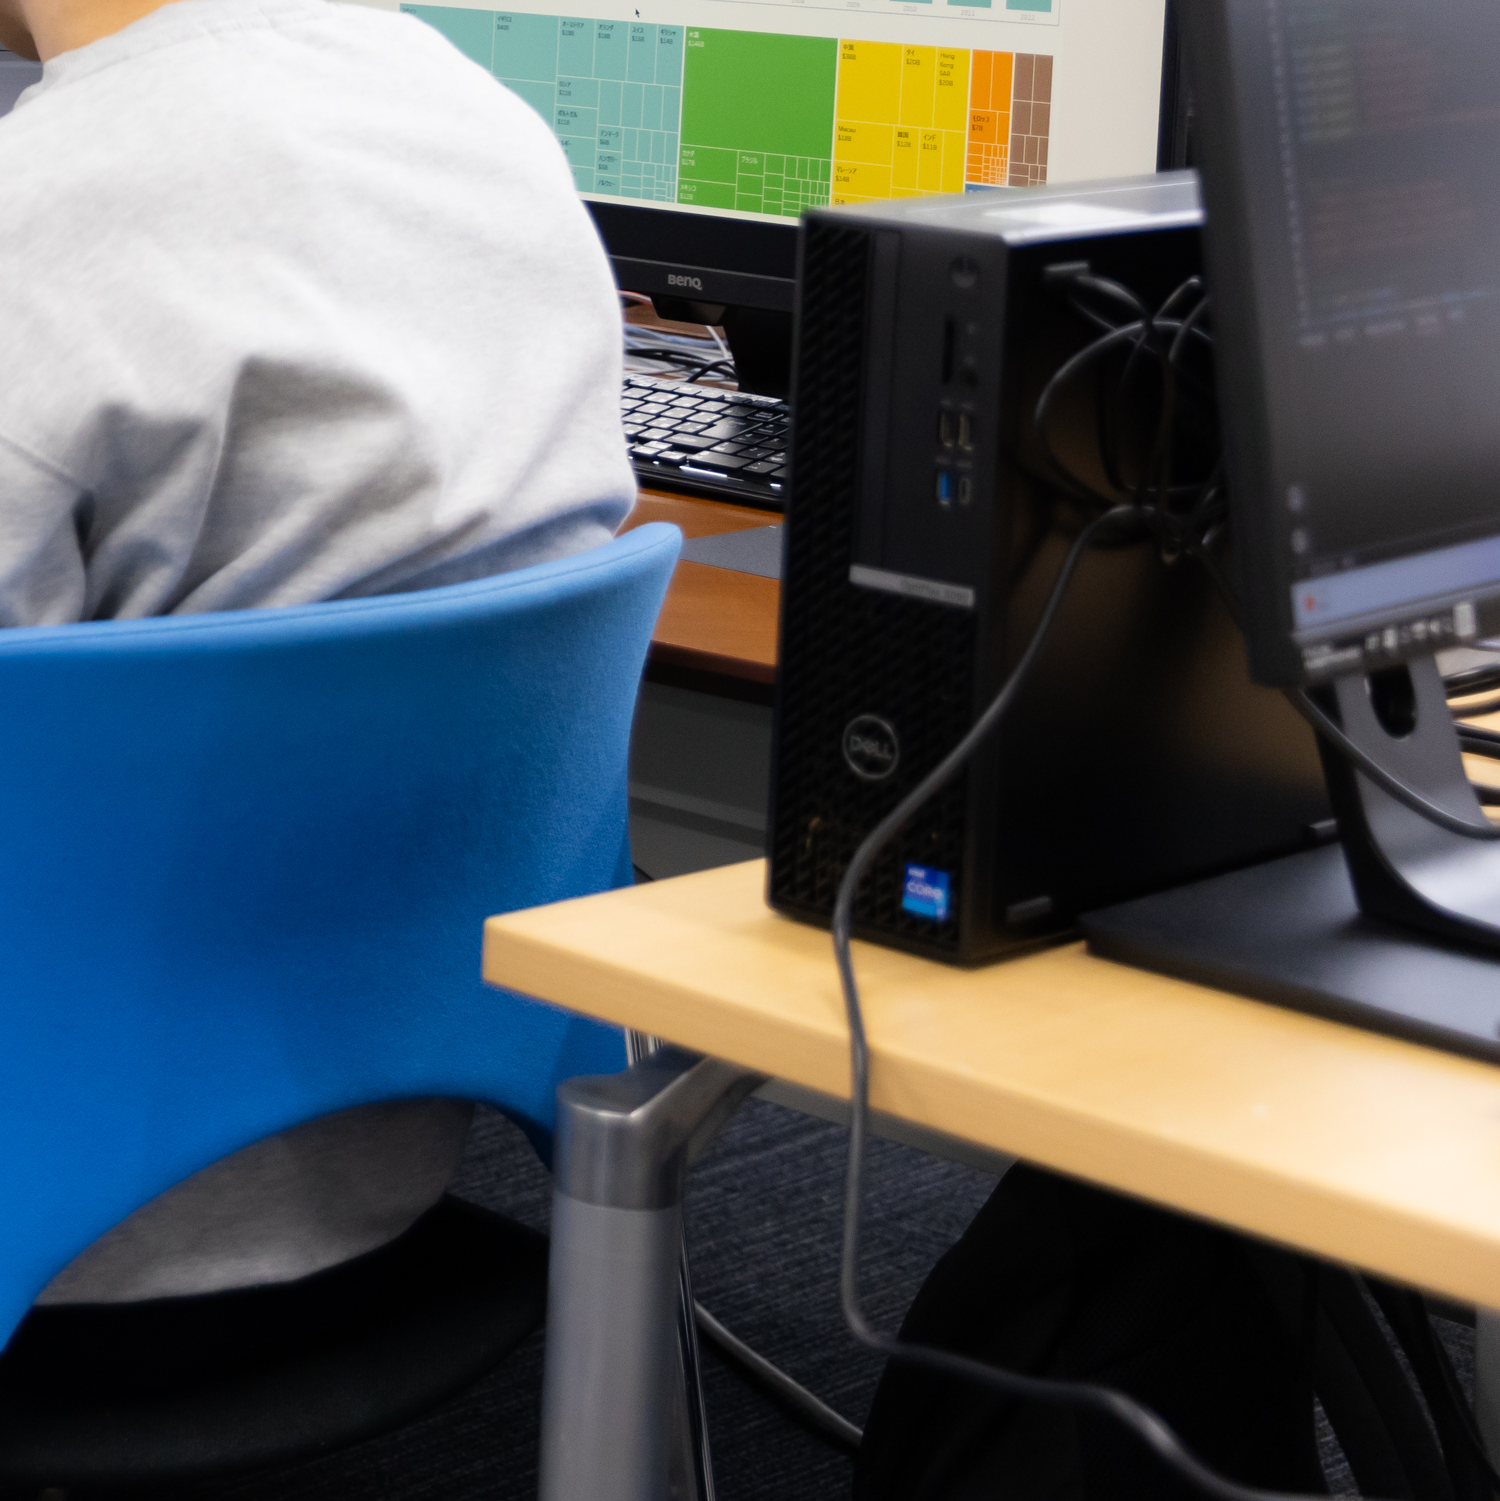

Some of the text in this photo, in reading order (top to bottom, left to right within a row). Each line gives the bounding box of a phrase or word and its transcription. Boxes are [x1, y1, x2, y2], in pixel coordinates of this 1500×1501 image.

[940, 52, 955, 60] Hong
[939, 62, 954, 70] Kong
[838, 125, 856, 133] Macau
[922, 133, 937, 141] インド
[836, 166, 857, 174] マレーシア
[667, 274, 703, 291] BenQ
[853, 734, 893, 760] DELL
